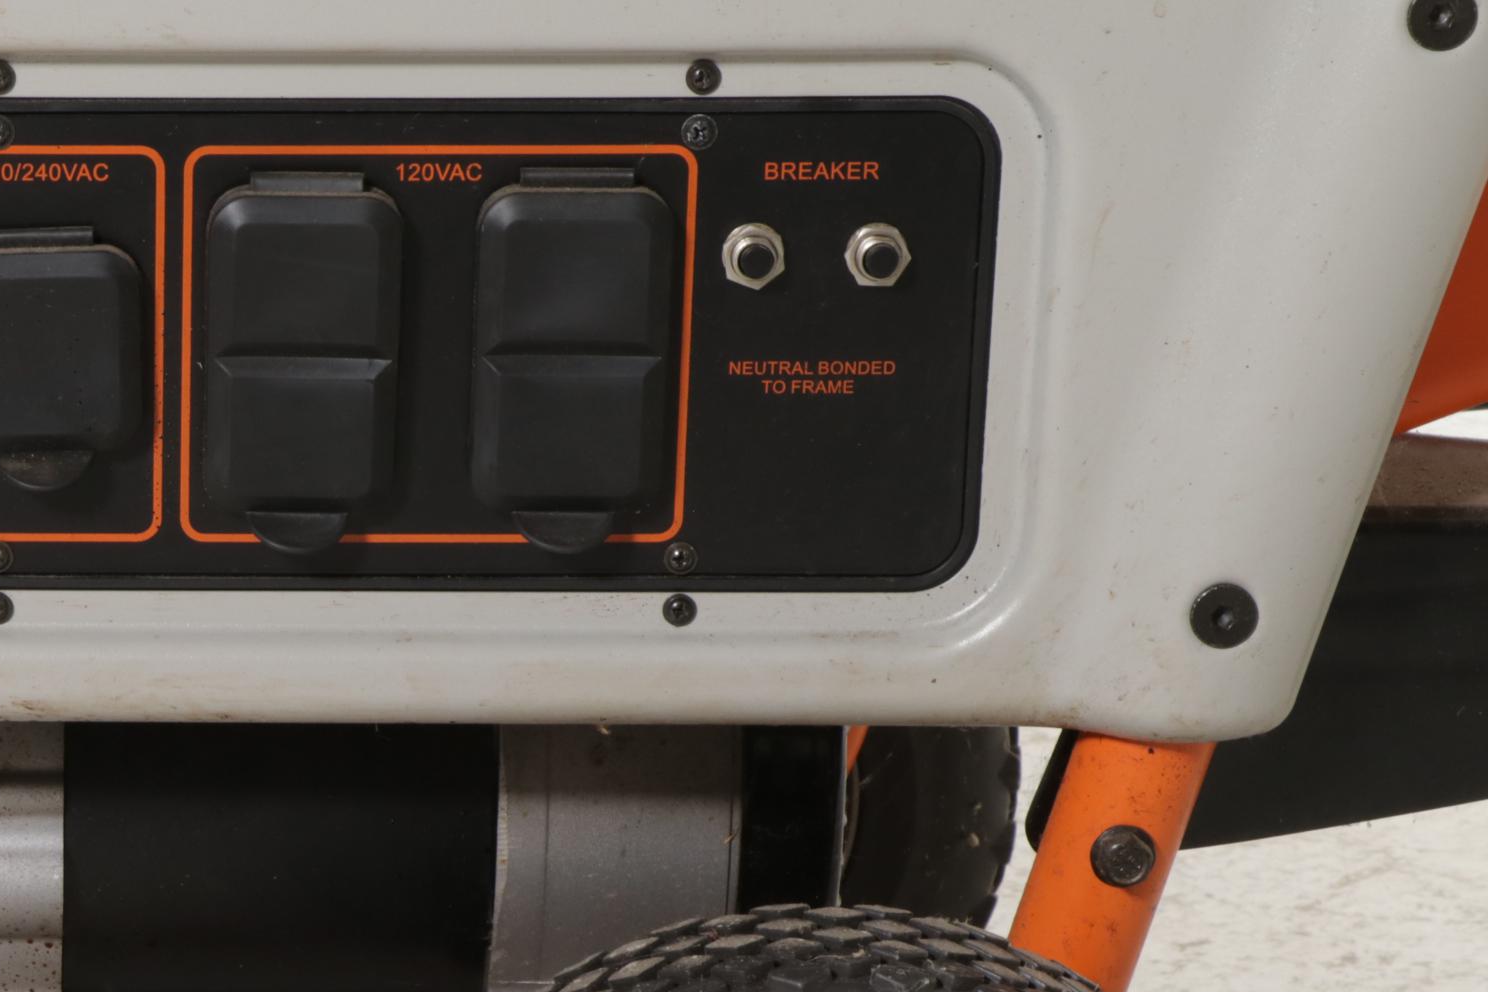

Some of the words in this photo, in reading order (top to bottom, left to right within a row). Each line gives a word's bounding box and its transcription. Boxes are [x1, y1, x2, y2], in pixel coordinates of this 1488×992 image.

[396, 162, 483, 182] 120VAC
[764, 162, 880, 181] BREAKER
[728, 361, 813, 375] NEUTRAL
[818, 361, 896, 375] BONDED
[762, 380, 786, 394] TO
[791, 380, 854, 394] FRAME
